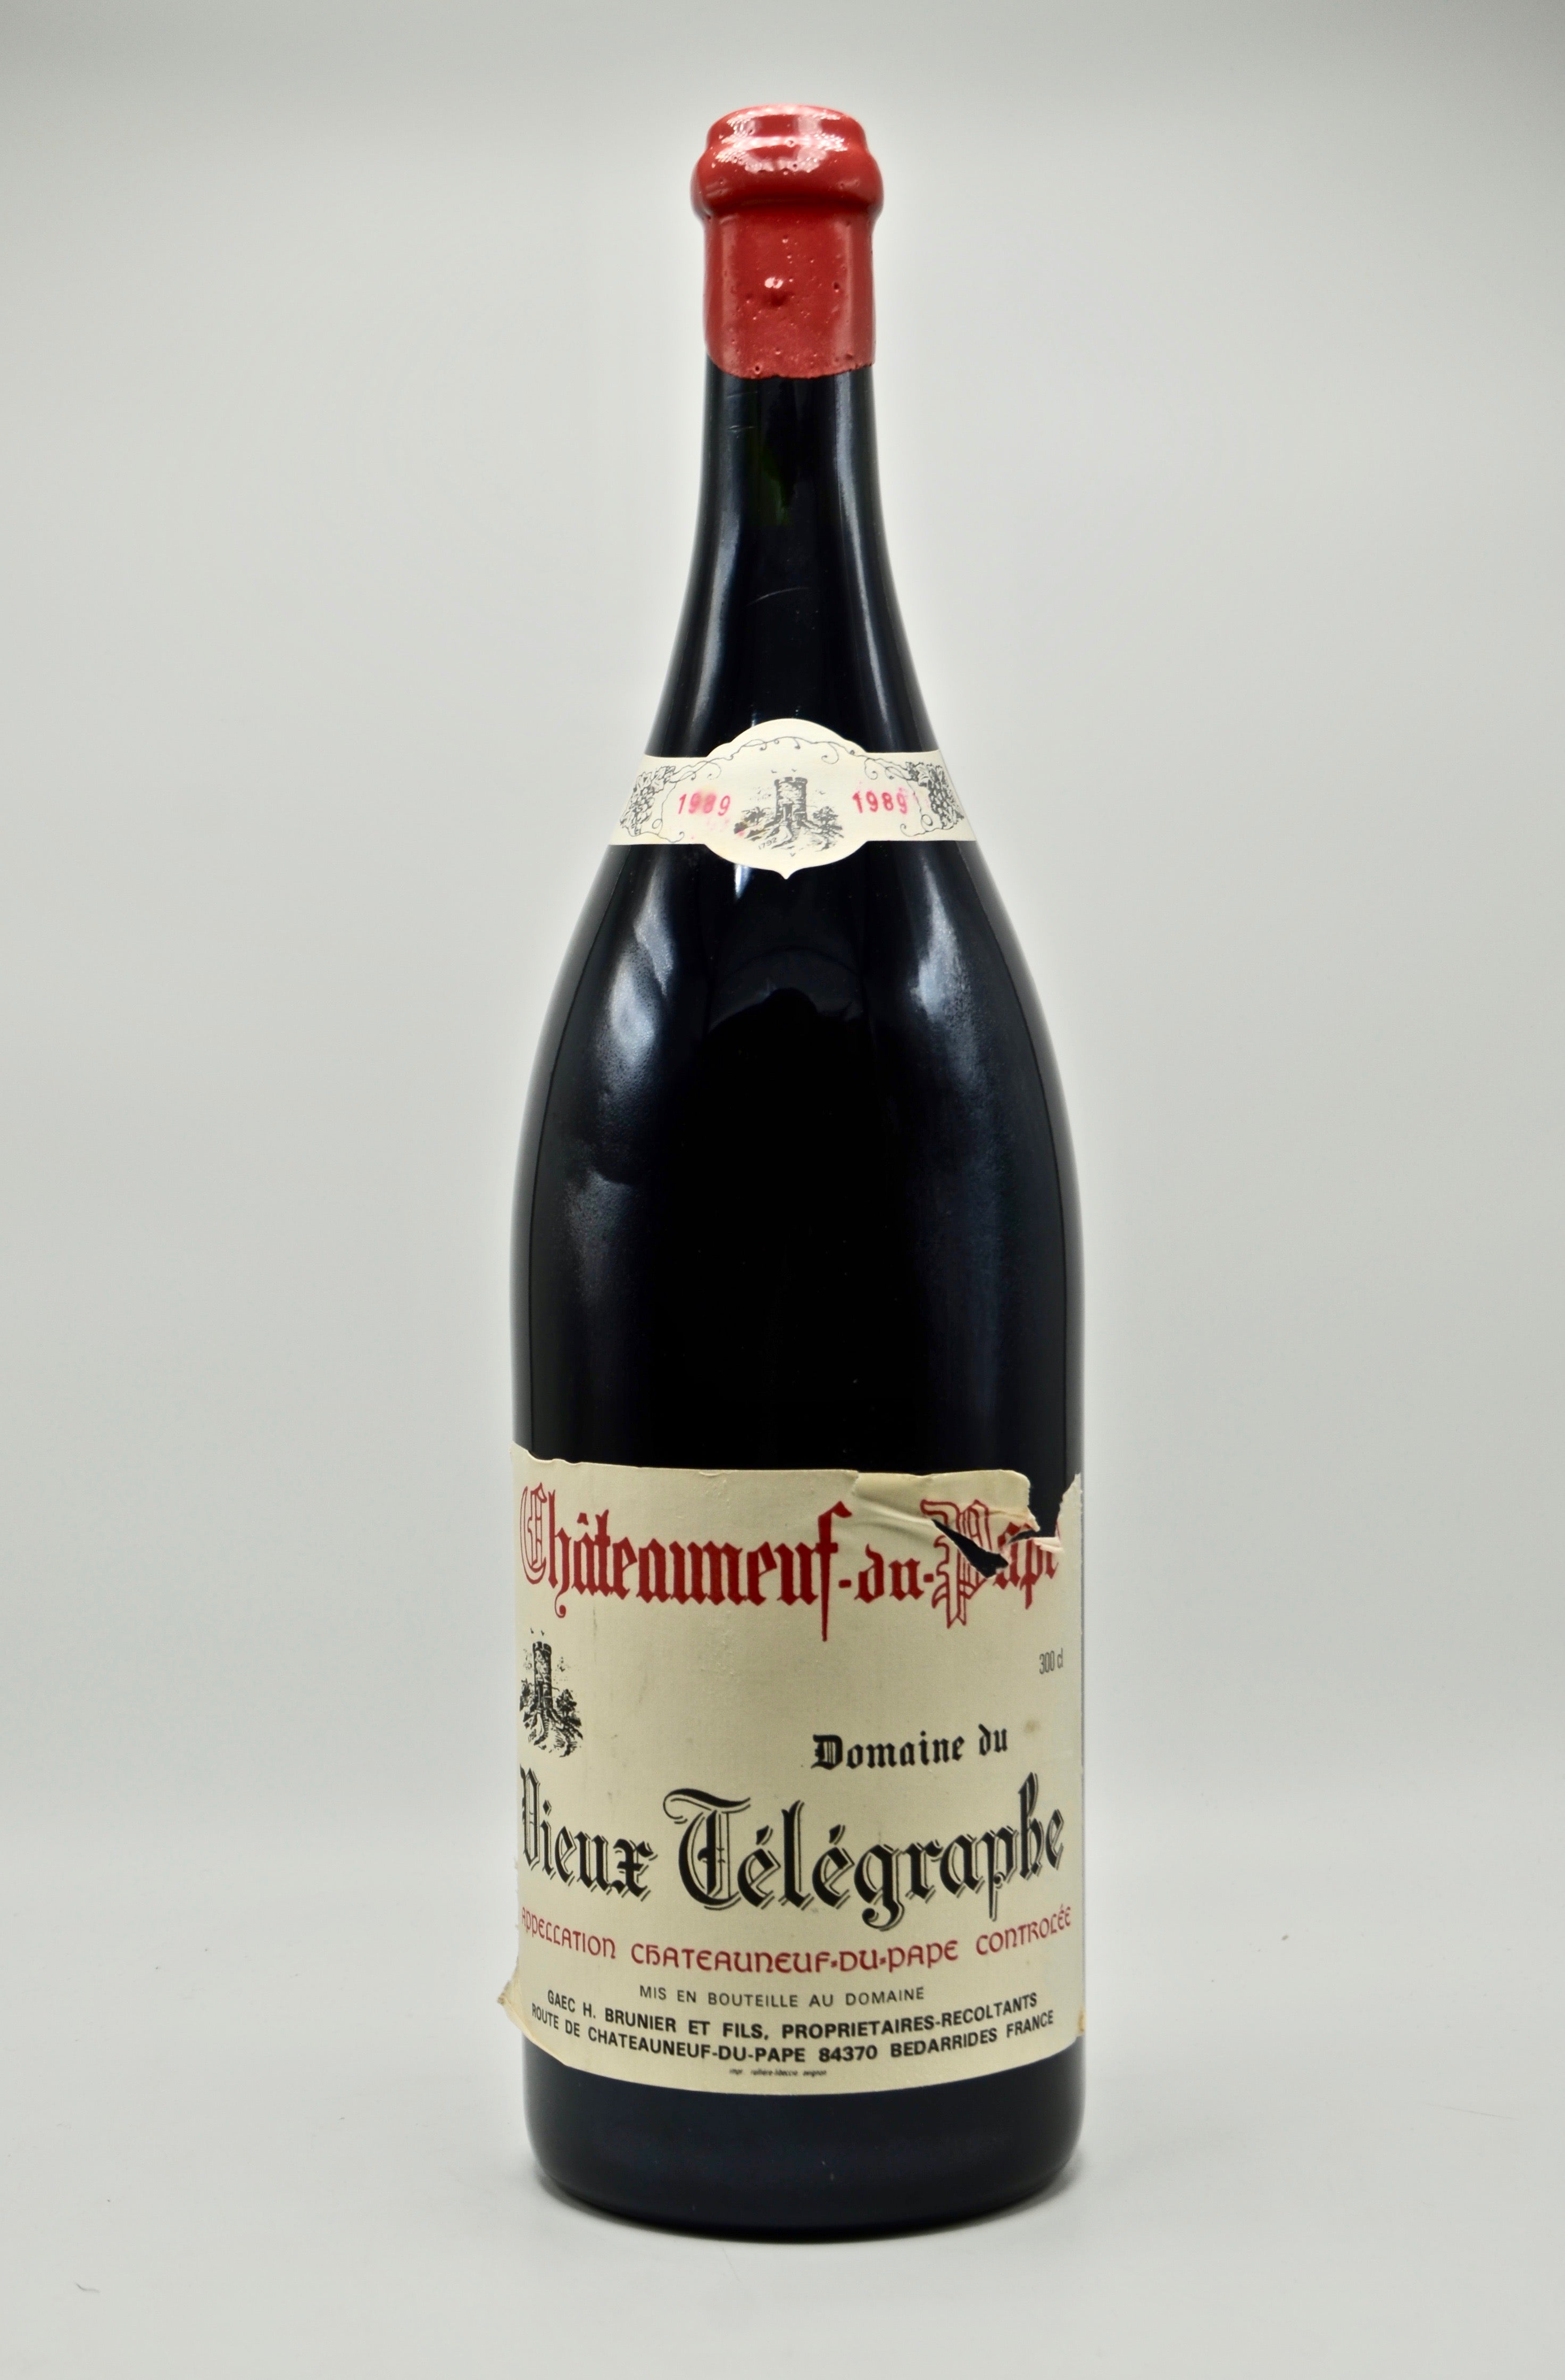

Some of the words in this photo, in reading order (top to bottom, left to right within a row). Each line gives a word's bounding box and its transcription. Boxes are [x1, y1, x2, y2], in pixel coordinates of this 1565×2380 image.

[852, 790, 908, 815] 1989
[1039, 1650, 1055, 1675] 300
[811, 1730, 965, 1769] Domaine
[979, 1724, 1008, 1756] du
[519, 1763, 658, 1902] Vieux
[662, 1771, 1064, 1932] Télégraphe
[522, 1907, 616, 1959] APPELLATION
[547, 1989, 576, 2013] GAEC
[583, 2002, 596, 2019] H.
[605, 2007, 677, 2033] BRUNIER
[688, 2020, 711, 2035] ET
[722, 2023, 769, 2041] FILS,
[781, 1992, 1037, 2039] PROPRIETAIRES-RECOLTANTS
[639, 1985, 667, 2001] MIS
[677, 1989, 697, 2003] EN
[708, 1992, 798, 2008] BOUTEILLE
[809, 1994, 834, 2007] AU
[845, 1986, 925, 2006] DOMAINE
[532, 2003, 559, 2030] ROUTE
[565, 2019, 580, 2037] DE
[588, 2027, 806, 2062] CHATEAUNEUF-DU-PAPE
[818, 2045, 878, 2062] 84370
[890, 2027, 997, 2058] BEDARRIDES
[1006, 2009, 1054, 2038] FRANCE
